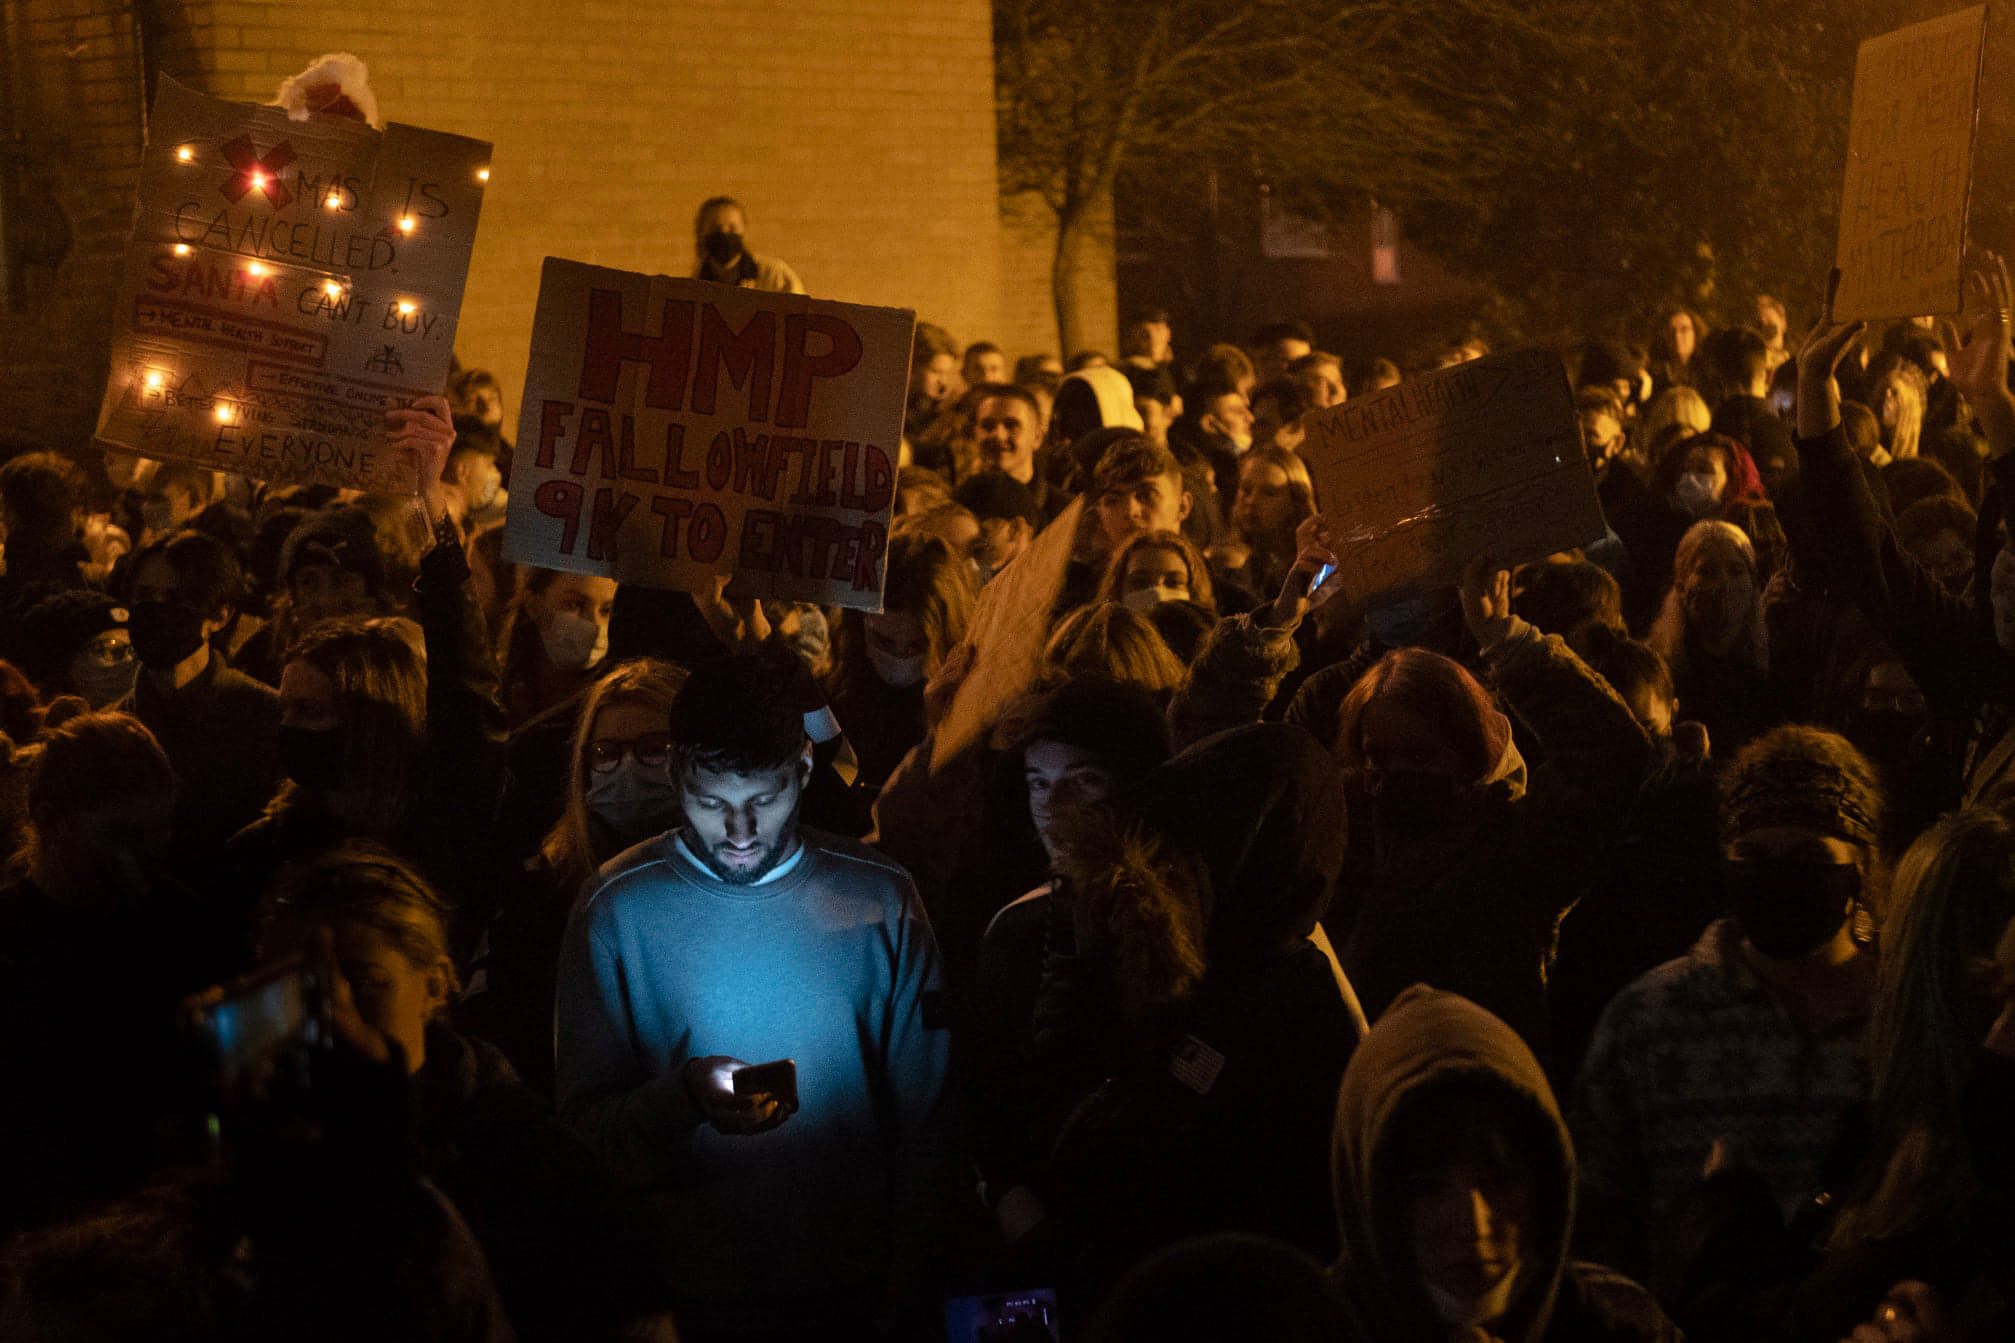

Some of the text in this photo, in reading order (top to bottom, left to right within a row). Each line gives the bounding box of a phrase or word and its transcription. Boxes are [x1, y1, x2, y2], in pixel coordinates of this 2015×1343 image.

[402, 176, 450, 224] IS
[145, 257, 277, 308] SANTA
[220, 321, 264, 343] HEALTH
[579, 288, 864, 429] HMP
[165, 389, 217, 411] BETTE
[215, 424, 376, 474] EVERYONE
[535, 400, 893, 514] FALLOWFIELD
[534, 480, 886, 593] 9K TO ENTER
